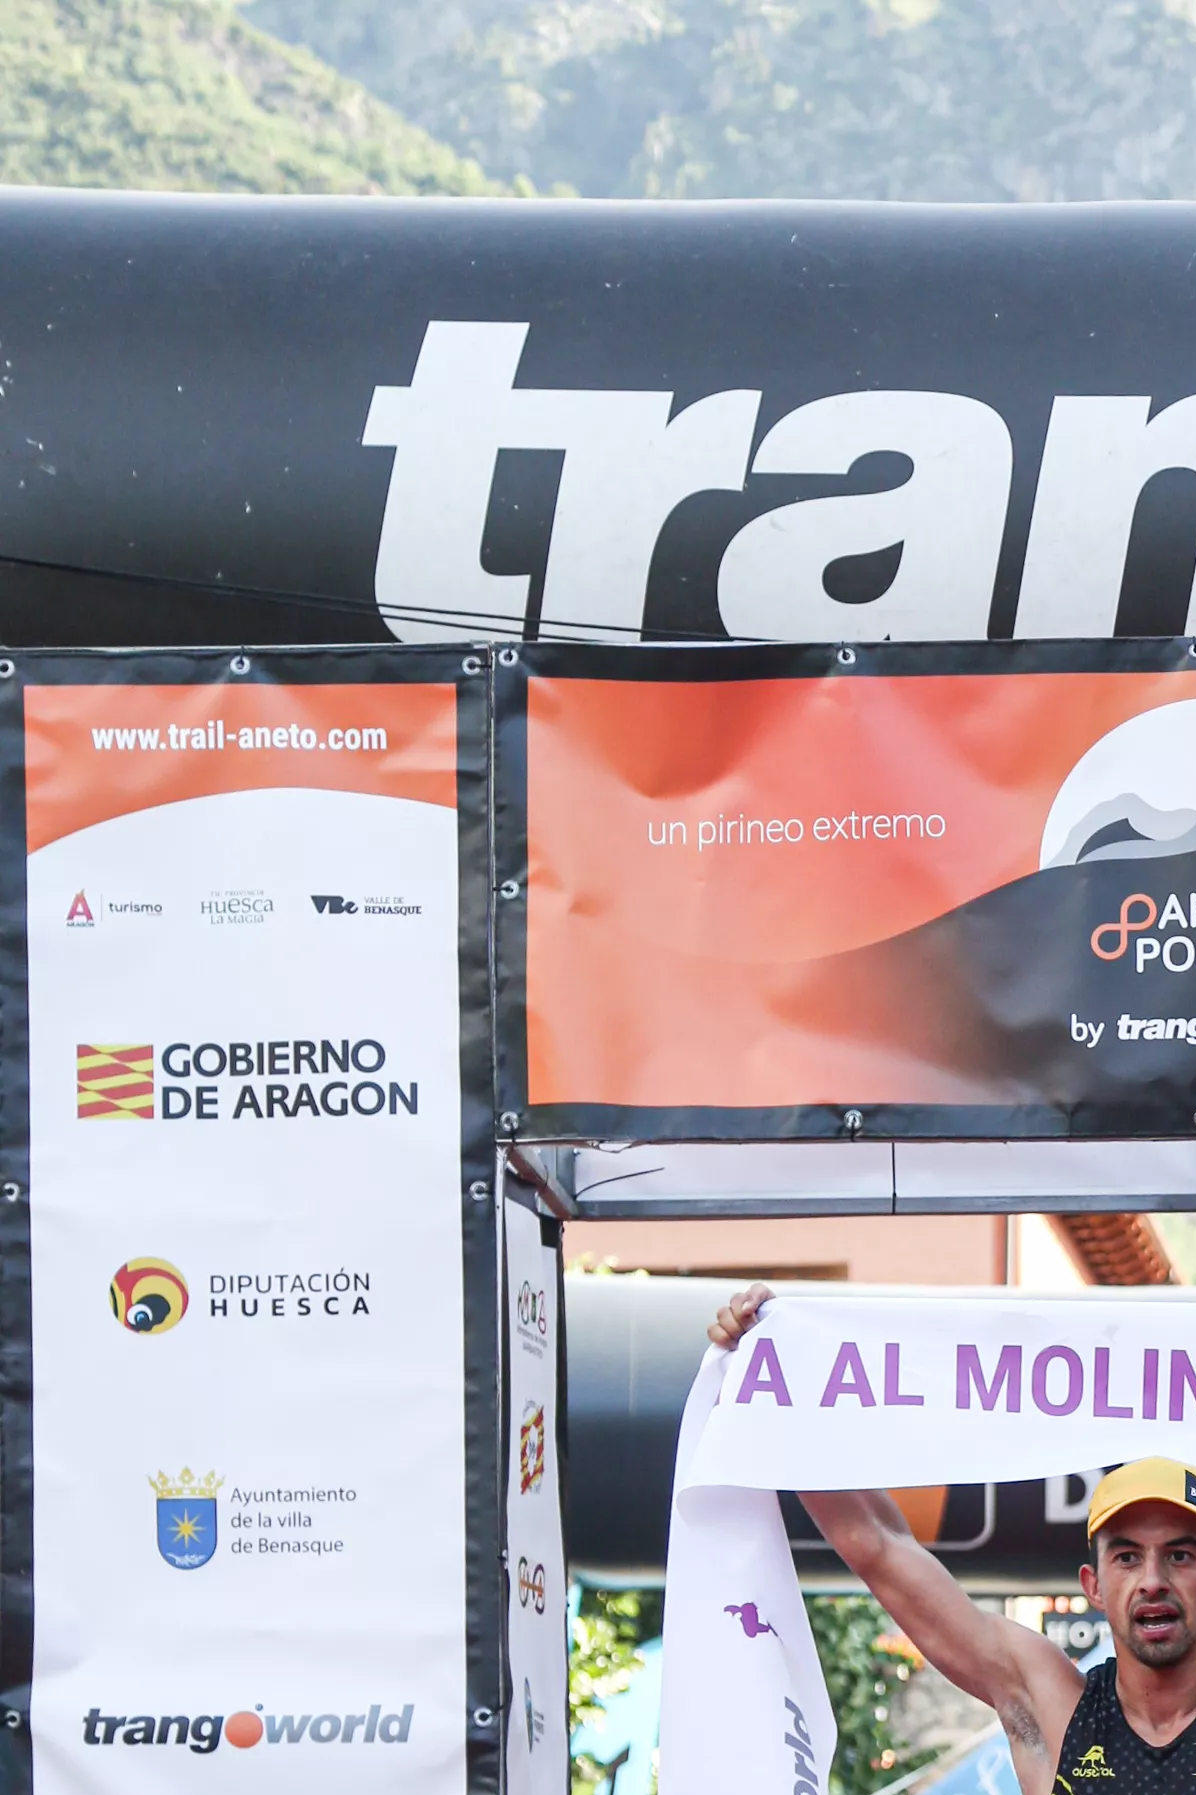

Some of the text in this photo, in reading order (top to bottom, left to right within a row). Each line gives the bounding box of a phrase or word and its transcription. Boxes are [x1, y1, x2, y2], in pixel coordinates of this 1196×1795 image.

[92, 720, 388, 751] www.trail-aneto.com
[648, 810, 946, 852] un pirineo extremo
[109, 901, 162, 913] turismo
[364, 897, 390, 905] VALLE
[364, 905, 422, 915] BENASQUE
[1070, 1013, 1105, 1047] by
[161, 1039, 386, 1077] GOBIERNO
[162, 1082, 418, 1120] DE ARAGON
[209, 1268, 370, 1294] DIPUTACIÓN
[210, 1297, 371, 1317] HUESCA
[719, 1338, 793, 1407] A
[820, 1342, 924, 1408] AL
[230, 1487, 357, 1506] Ayuntamiento
[230, 1512, 312, 1529] de la villa
[230, 1536, 345, 1557] de Benasque
